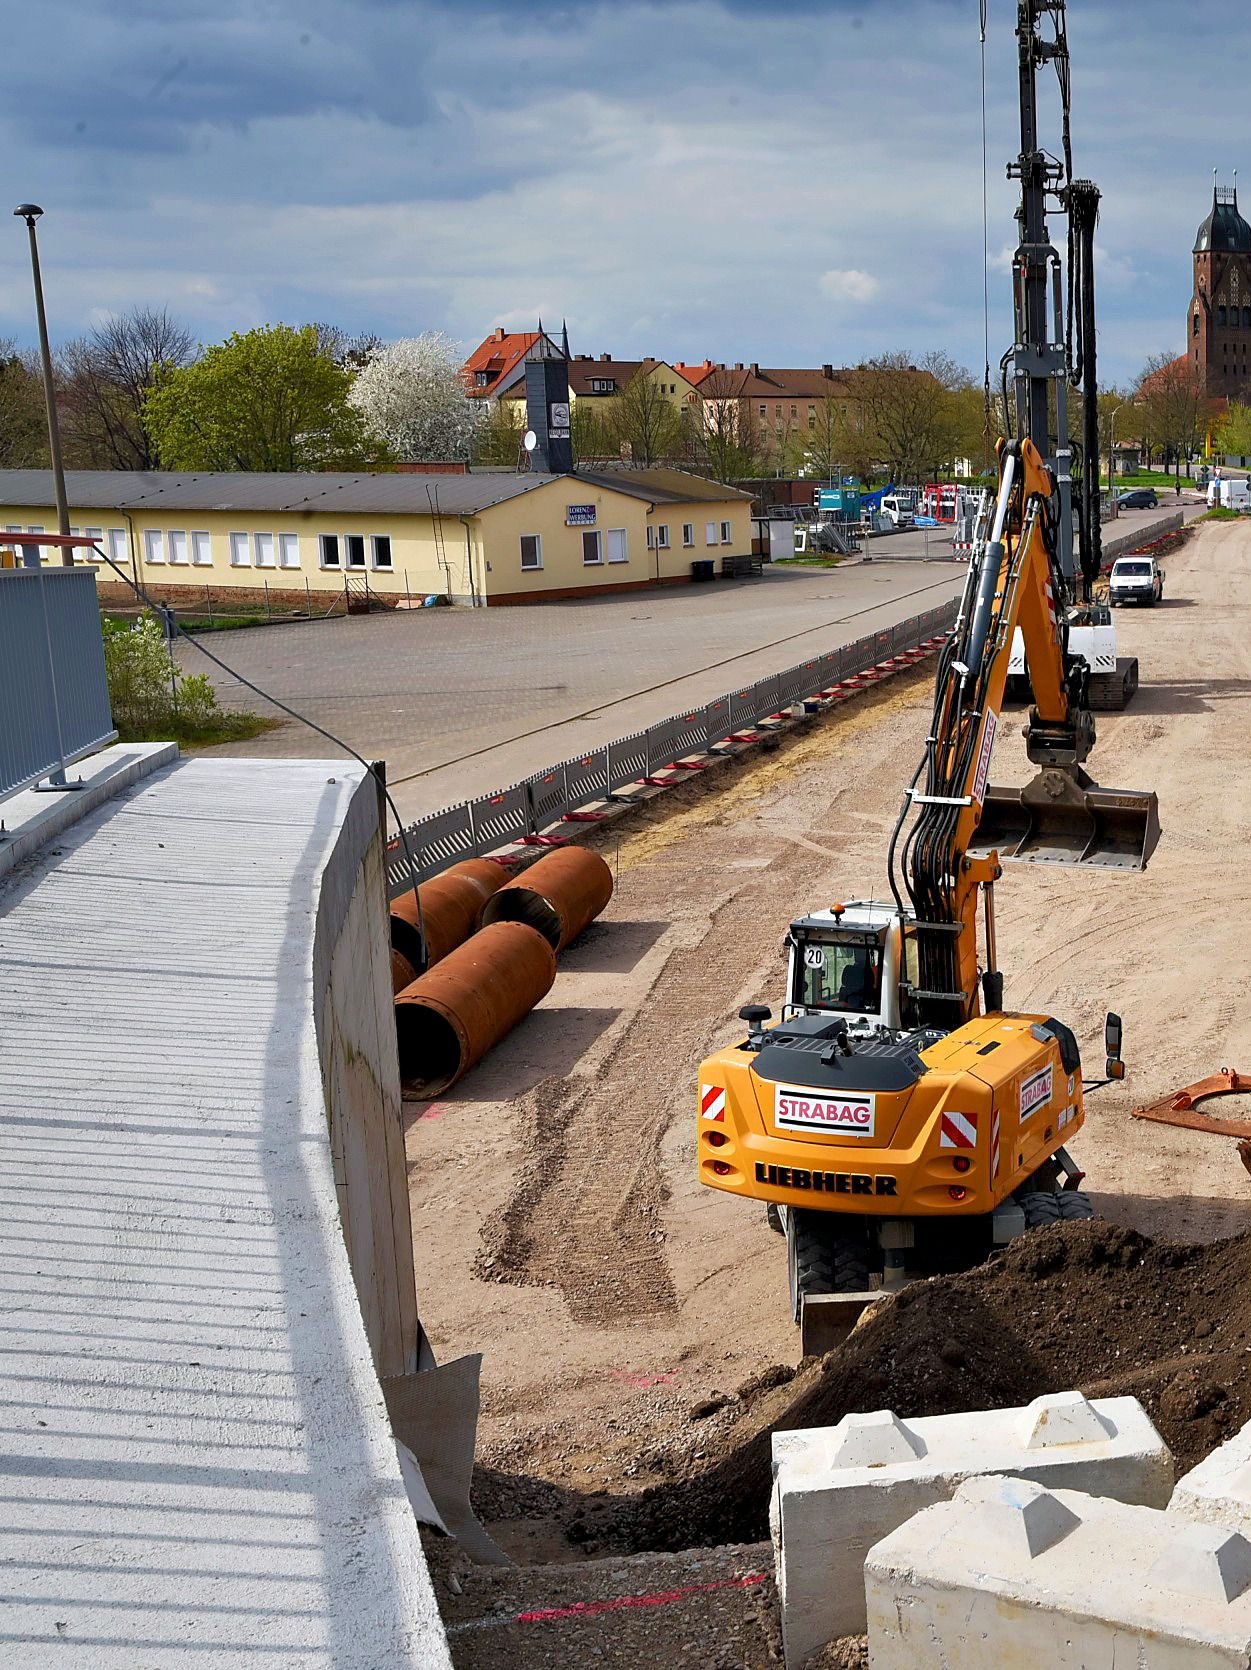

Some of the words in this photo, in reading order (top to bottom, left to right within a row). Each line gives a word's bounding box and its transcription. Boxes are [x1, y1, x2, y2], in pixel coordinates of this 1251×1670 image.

[975, 715, 995, 798] STRABAG
[808, 949, 822, 964] 20
[1021, 1074, 1052, 1111] STRABAG
[778, 1098, 870, 1124] STRABAG
[754, 1160, 898, 1196] LIEBHERR
